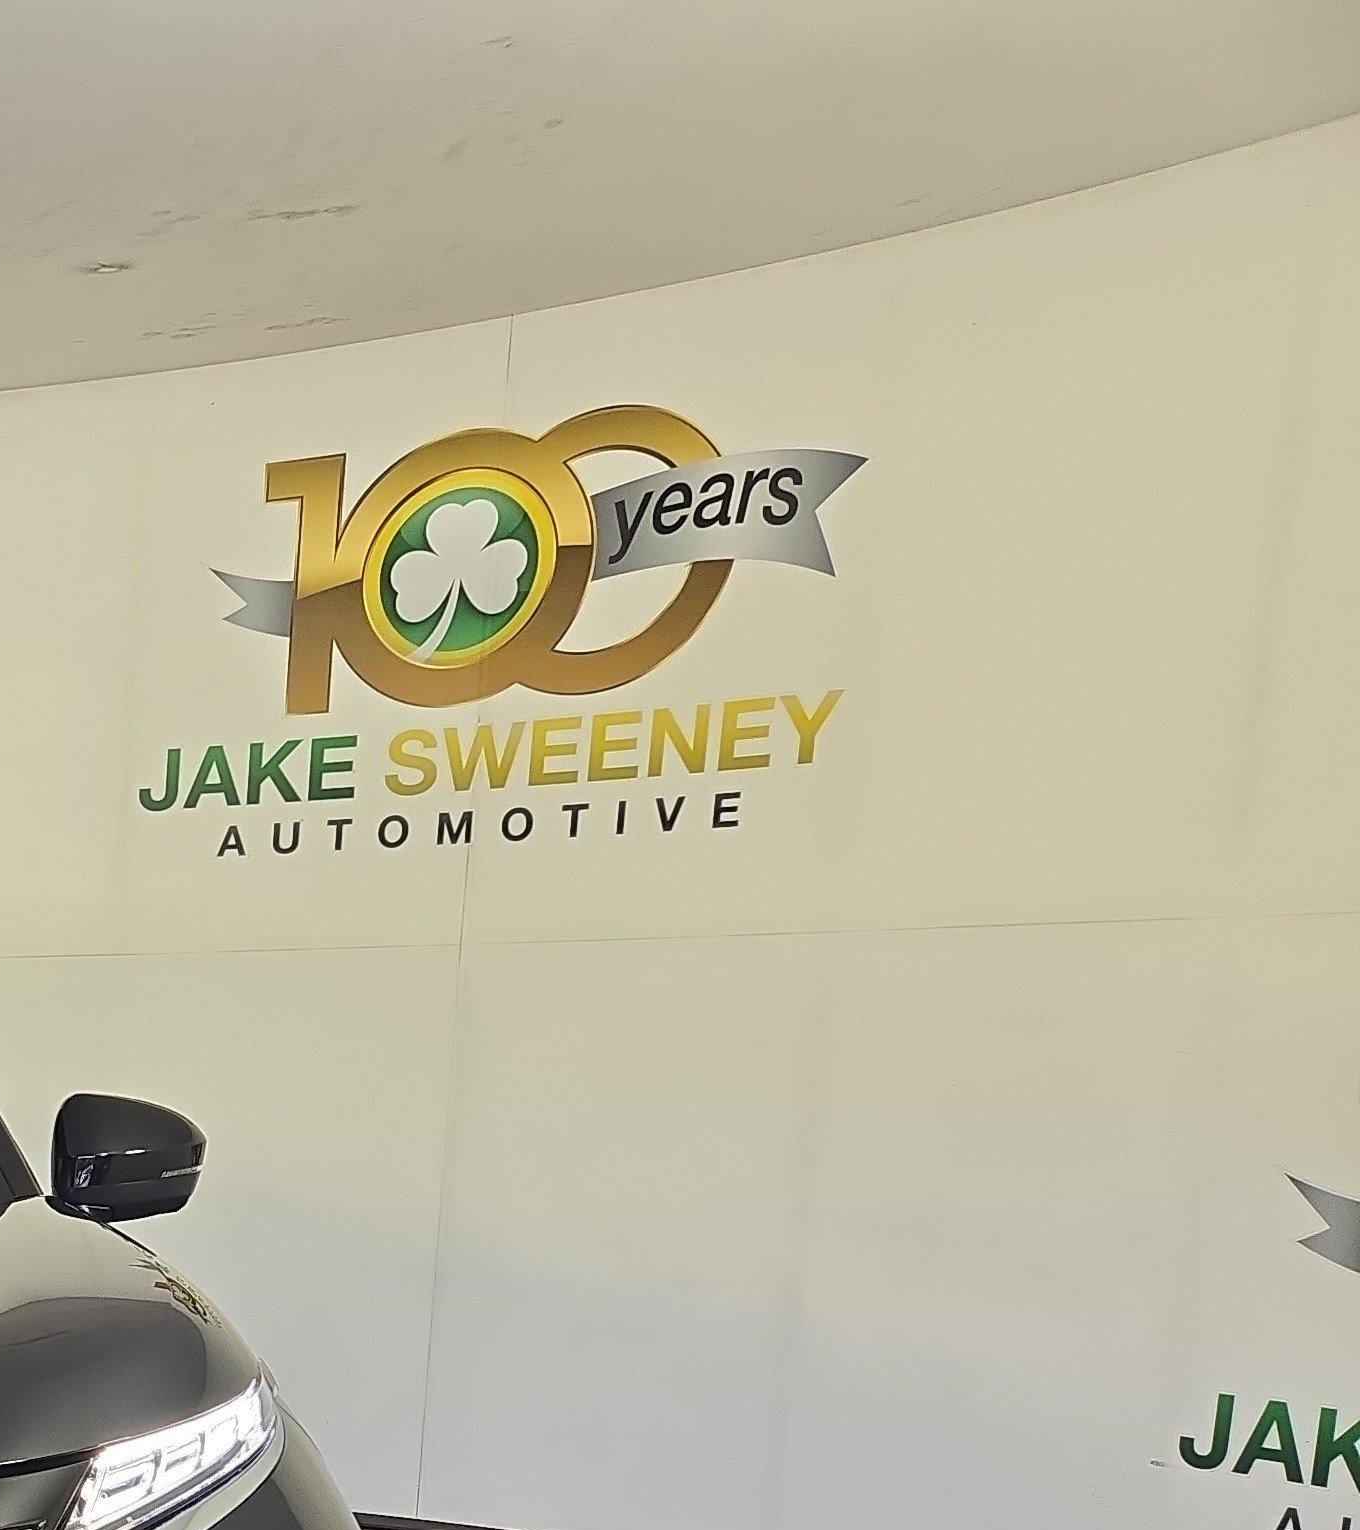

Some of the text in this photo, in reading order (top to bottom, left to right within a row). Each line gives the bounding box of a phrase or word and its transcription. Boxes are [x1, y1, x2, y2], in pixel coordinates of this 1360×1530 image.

[608, 465, 804, 565] years
[138, 689, 845, 812] JAKE SWEENEY
[216, 792, 742, 858] AUTOMOTIVE
[1179, 1393, 1360, 1494] JAK
